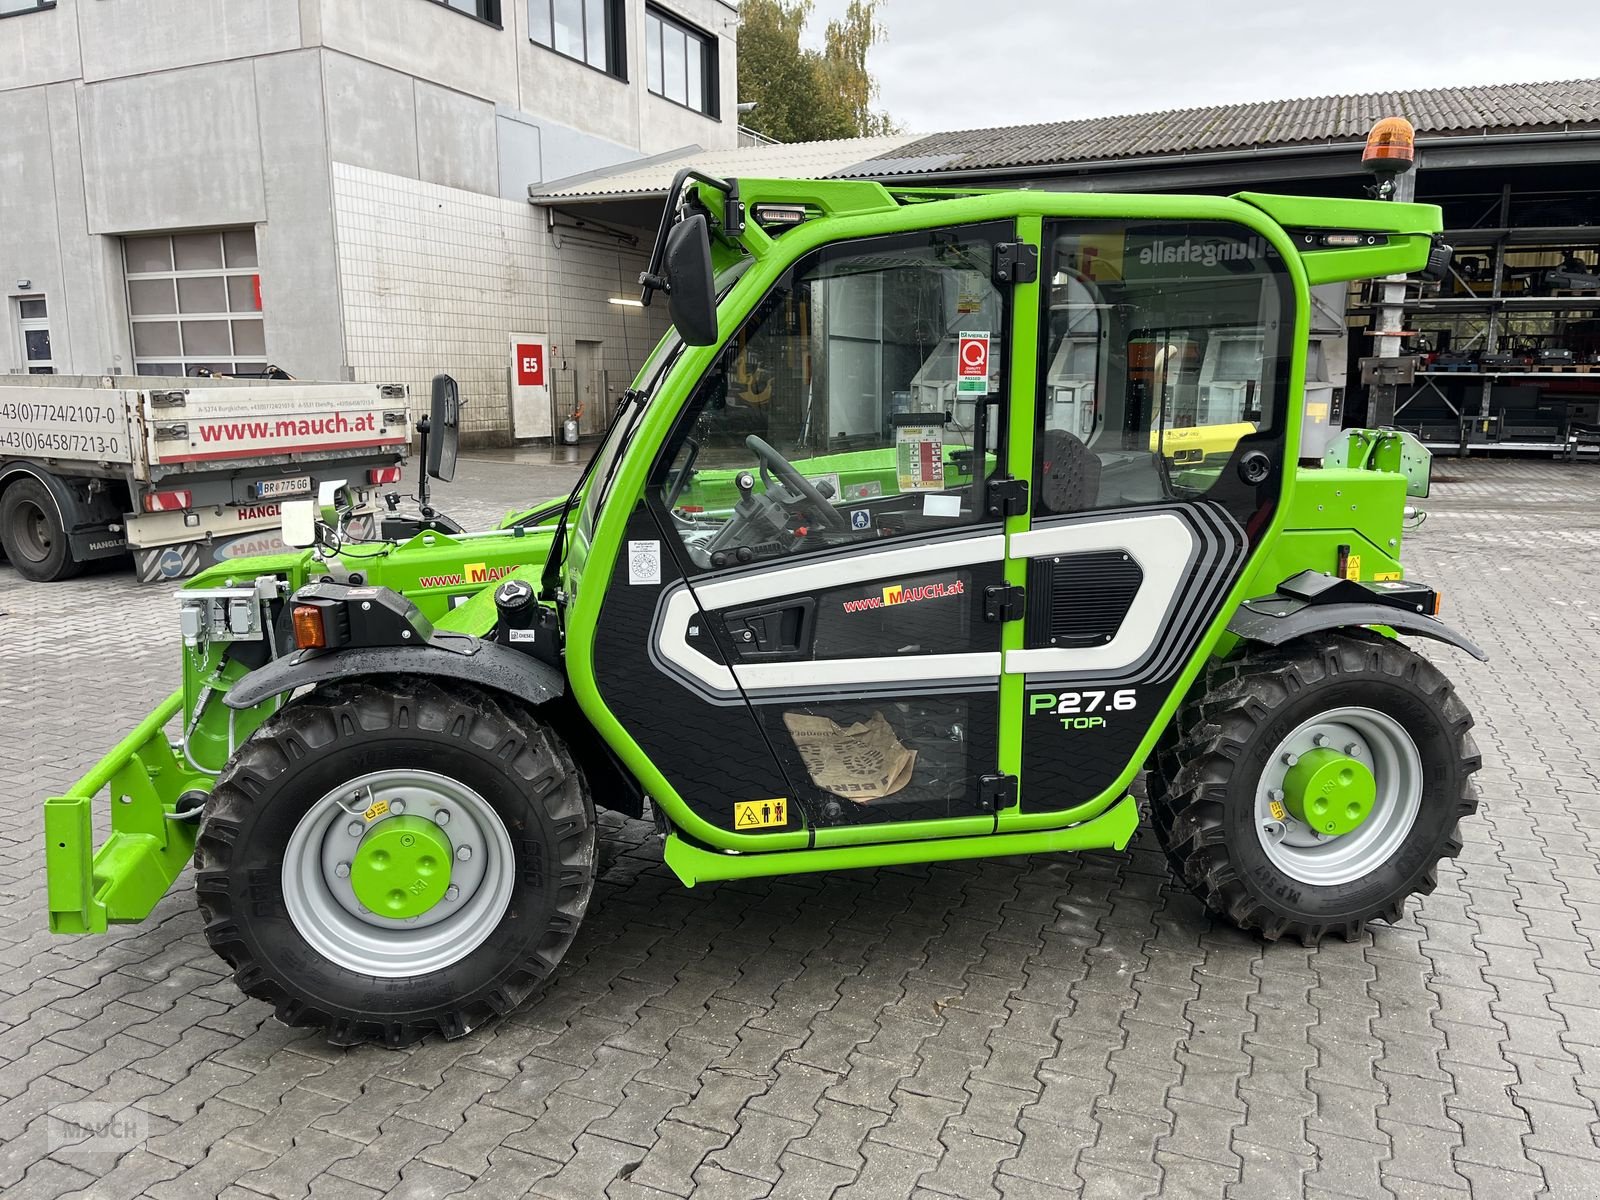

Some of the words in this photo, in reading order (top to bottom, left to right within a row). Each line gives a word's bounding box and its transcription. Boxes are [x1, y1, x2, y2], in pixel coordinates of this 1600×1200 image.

[962, 341, 985, 367] Q
[523, 357, 538, 373] E5
[199, 411, 375, 442] www.mauch.at
[0, 431, 118, 454] +43(0)6458/7213-0
[264, 483, 275, 493] BR
[238, 504, 282, 521] HANGL
[89, 539, 127, 551] HANGLE
[231, 537, 283, 556] HANG
[420, 564, 521, 588] www.MAU
[843, 580, 964, 613] www.MAUCH.at
[825, 782, 877, 792] BER
